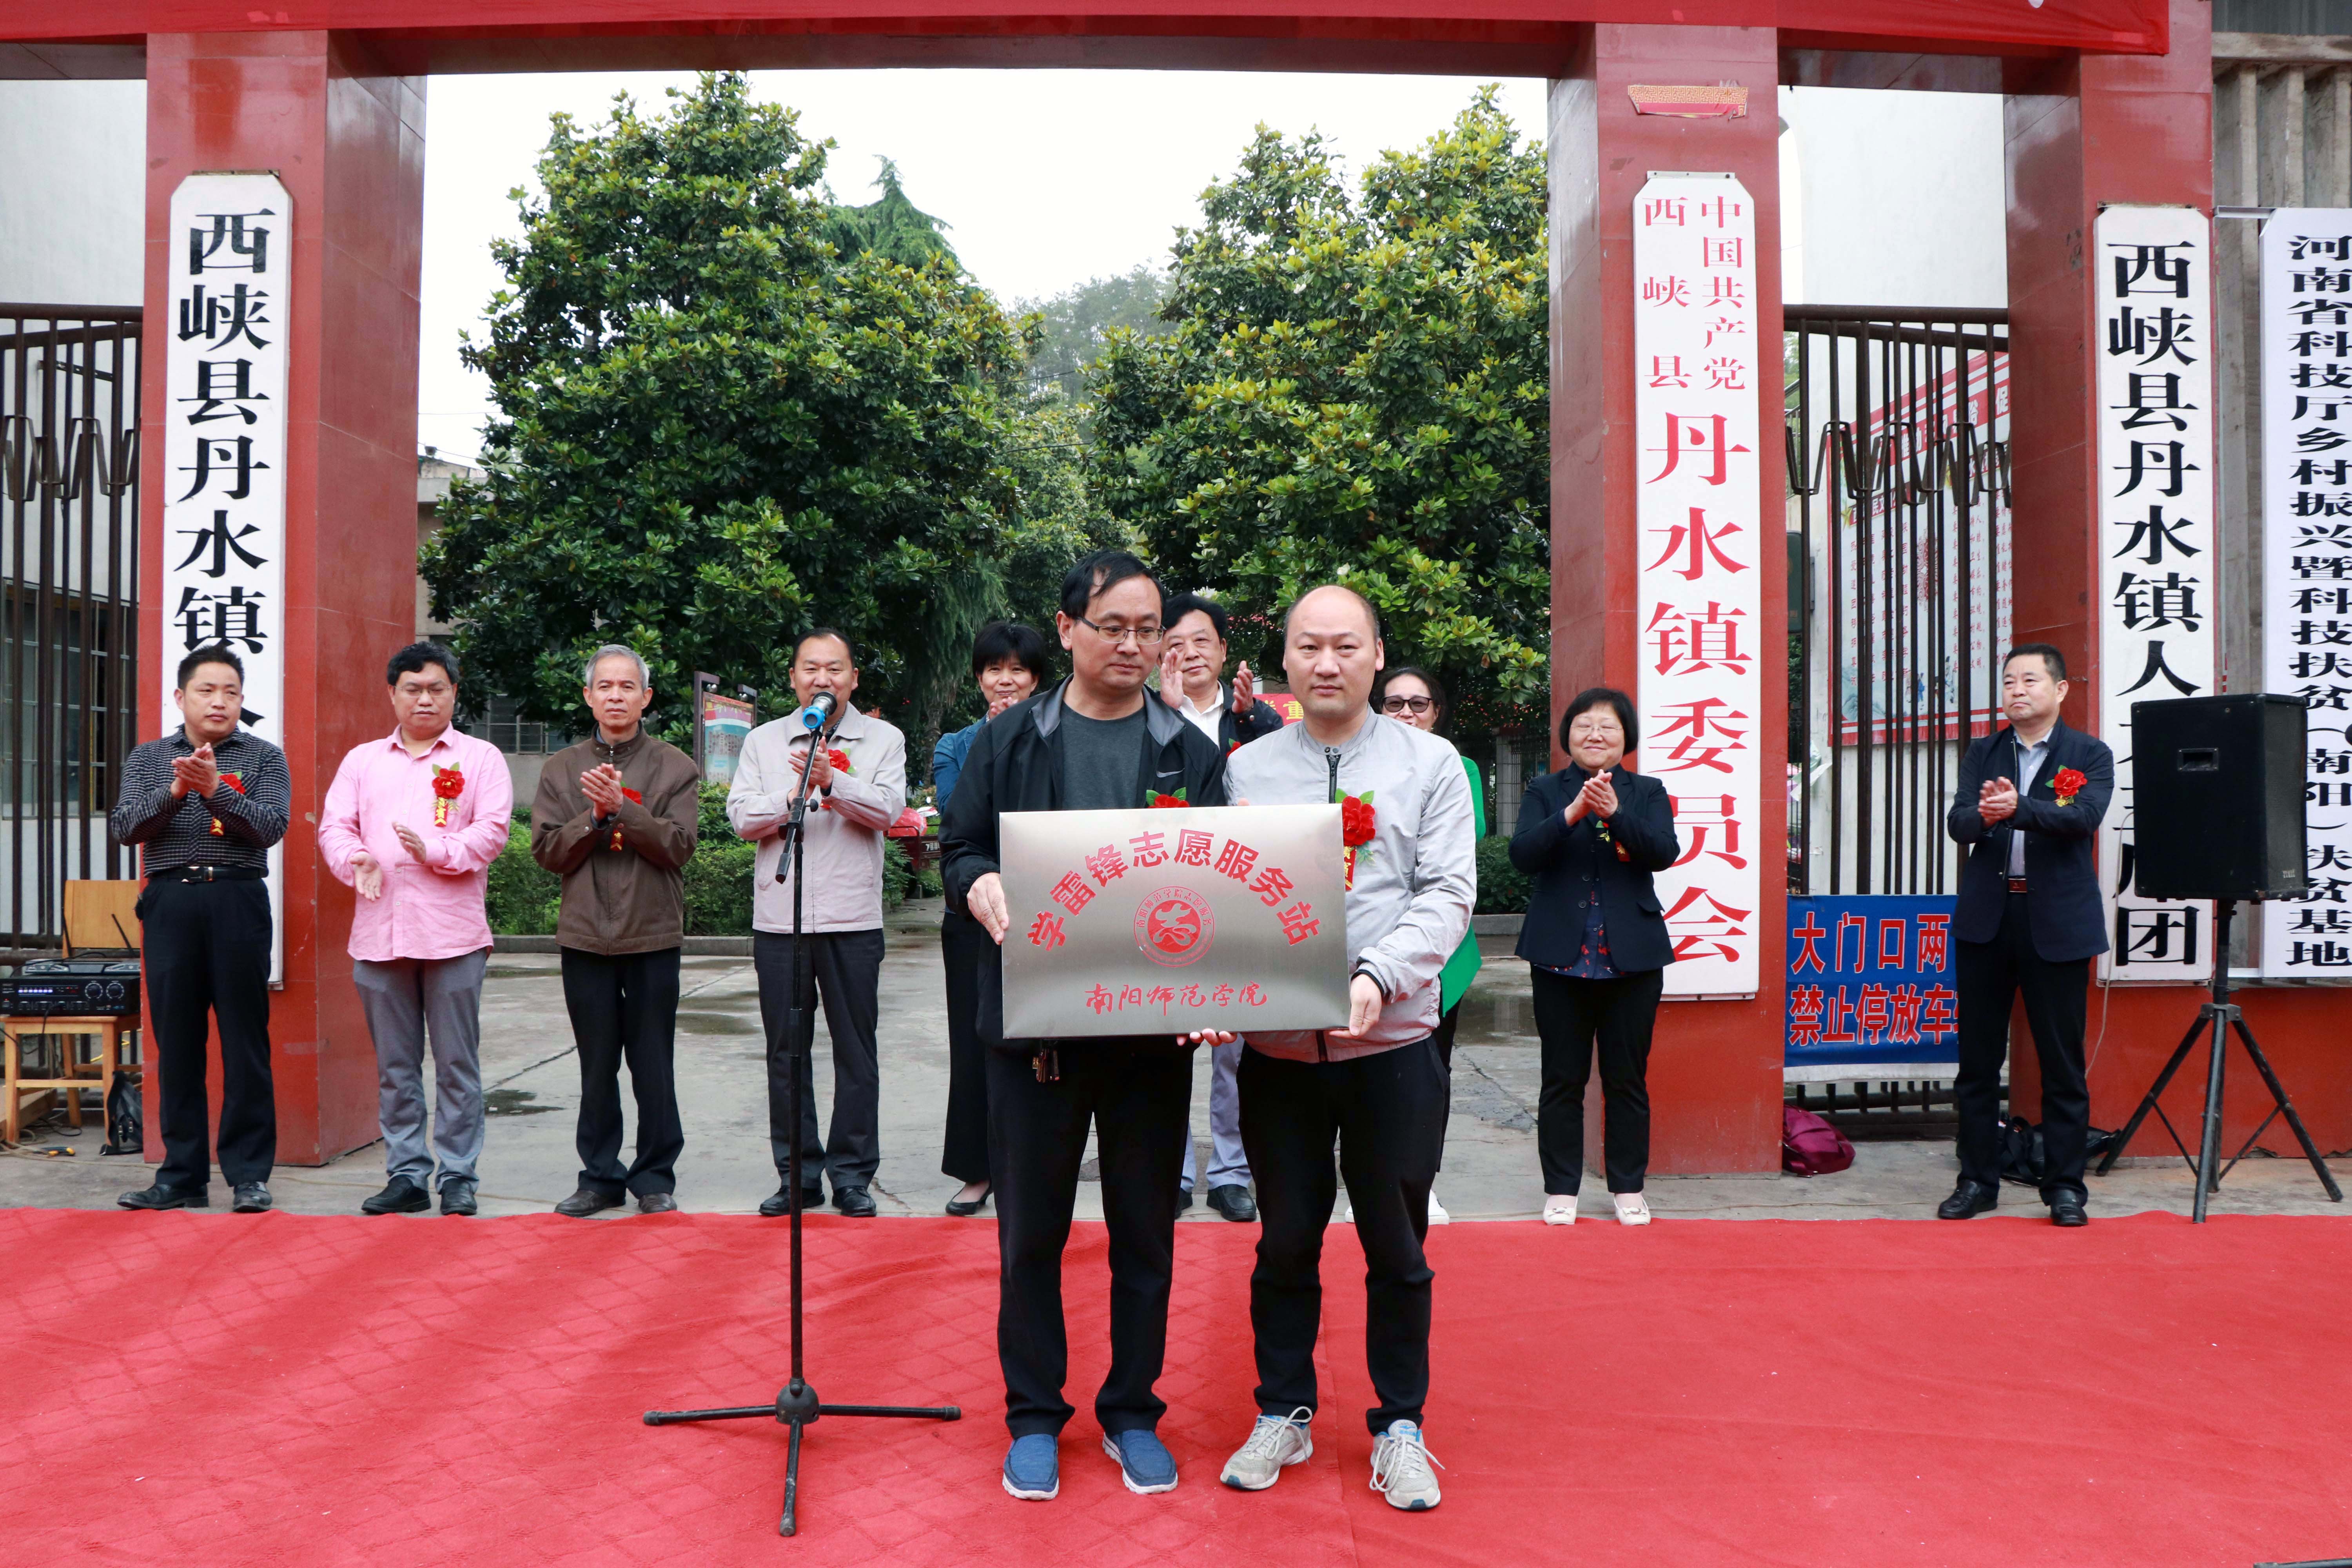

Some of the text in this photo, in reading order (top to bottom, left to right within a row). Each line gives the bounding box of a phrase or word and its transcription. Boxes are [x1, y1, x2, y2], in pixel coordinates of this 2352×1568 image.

[1642, 196, 1693, 388] 西峡县
[1701, 196, 1746, 390] 中国共产党
[174, 209, 276, 727] 西峡县丹水镇
[1644, 412, 1753, 963] 丹水镇委员会
[2107, 241, 2203, 966] 西峡县丹水镇人团
[1027, 829, 1320, 951] 学雷锋志愿服务站
[1791, 911, 1951, 975] 大门口两
[1085, 980, 1267, 1016] 南阳师范学院
[1788, 983, 1958, 1046] 禁止停放车
